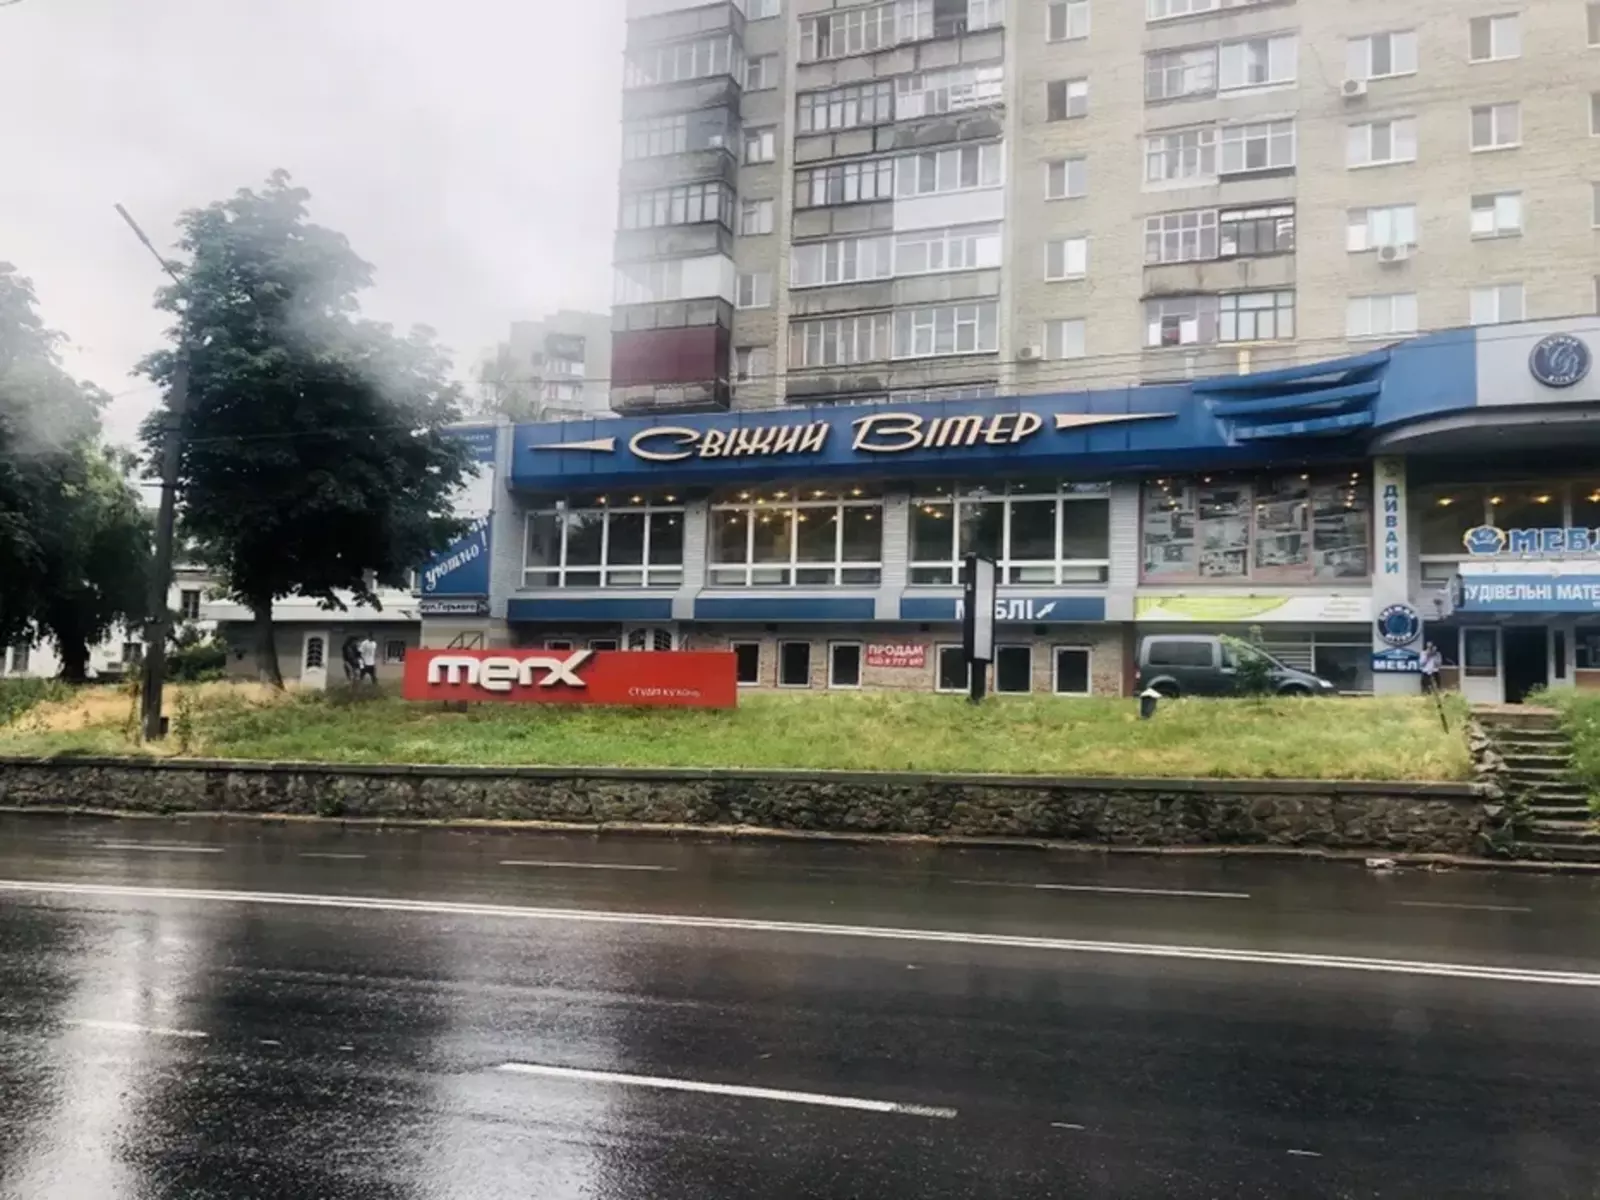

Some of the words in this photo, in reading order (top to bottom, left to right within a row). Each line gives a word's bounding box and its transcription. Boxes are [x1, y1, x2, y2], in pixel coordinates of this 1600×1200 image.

[629, 421, 831, 461] СВІЖИЙ
[852, 411, 1043, 453] ВІТЕР
[1383, 484, 1400, 574] ДИВАНИ
[955, 599, 1034, 620] МБЛІ
[868, 644, 924, 657] ПРОДАМ
[1373, 659, 1418, 671] МЕБЛ
[428, 648, 595, 692] merx
